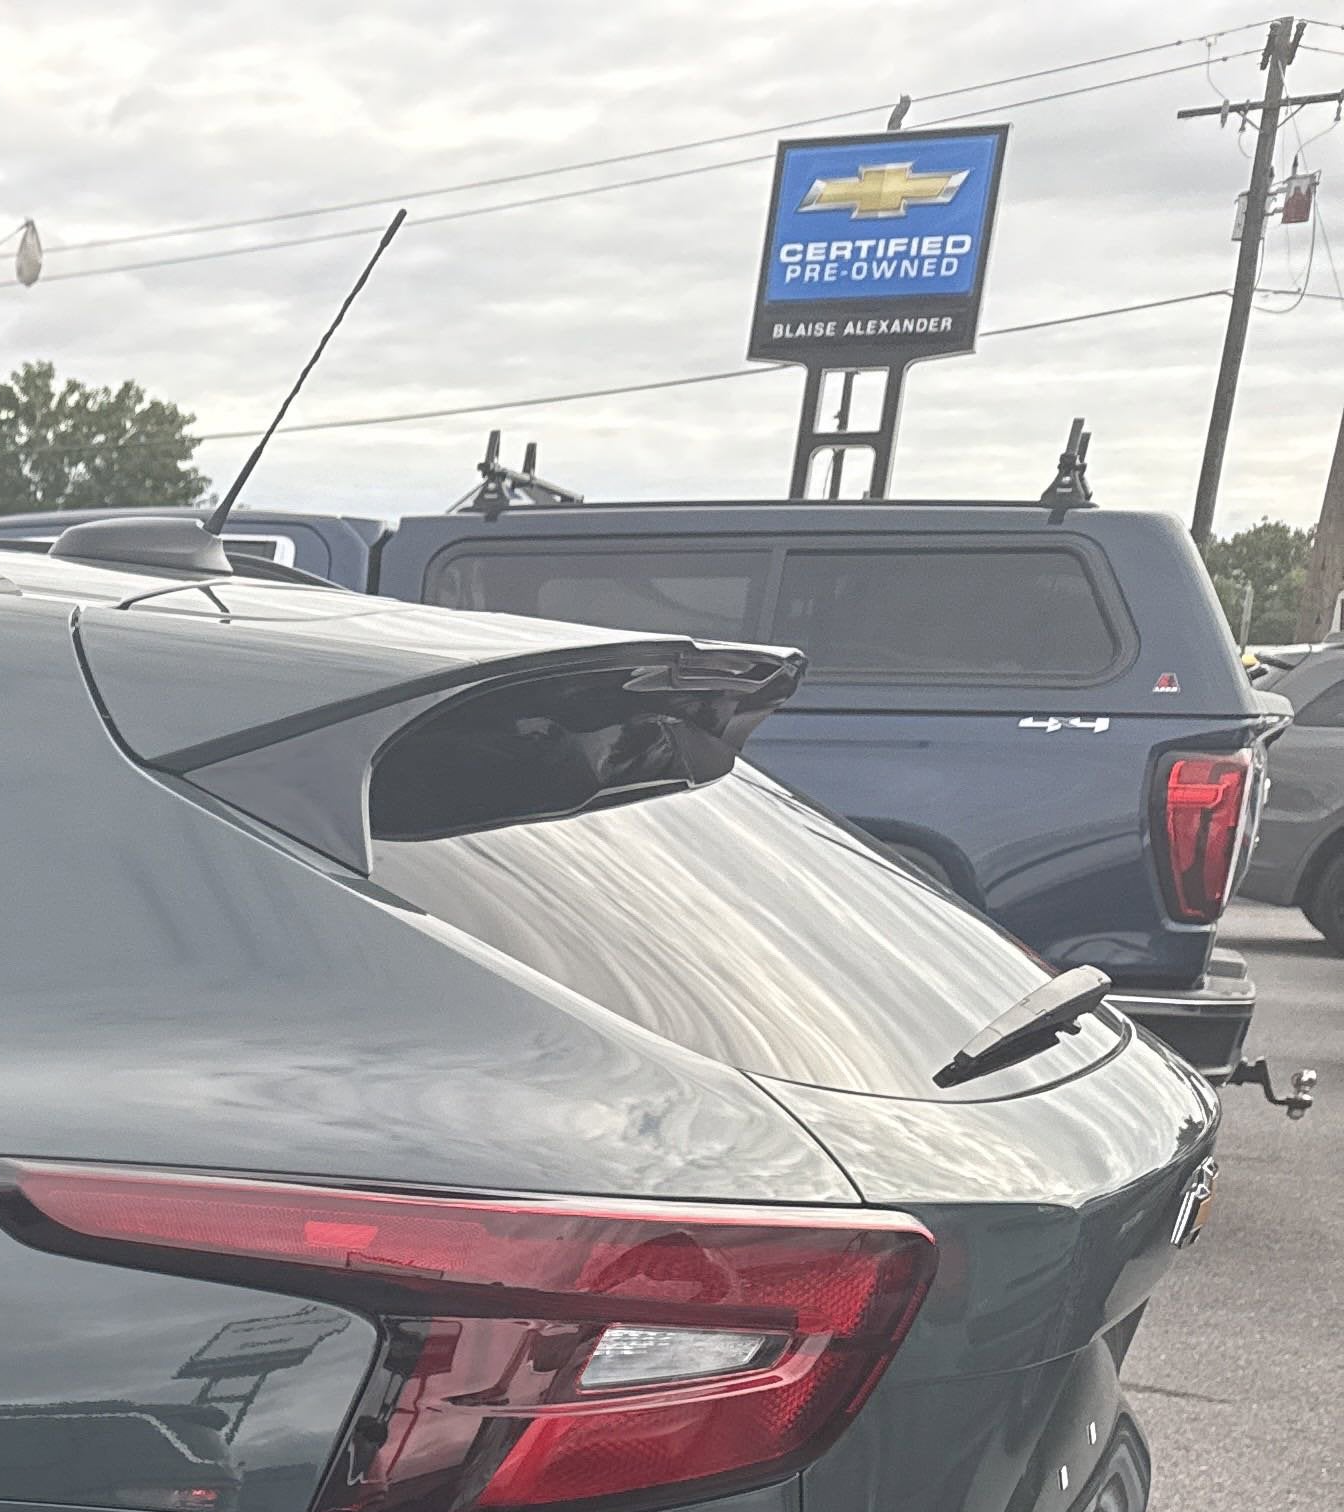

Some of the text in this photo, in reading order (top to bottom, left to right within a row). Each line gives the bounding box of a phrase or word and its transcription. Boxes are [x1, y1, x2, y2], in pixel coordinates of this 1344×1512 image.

[780, 234, 972, 263] CERTIFIED
[785, 257, 959, 283] PRE-OWNED
[772, 316, 953, 339] BLAISE ALEXANDER
